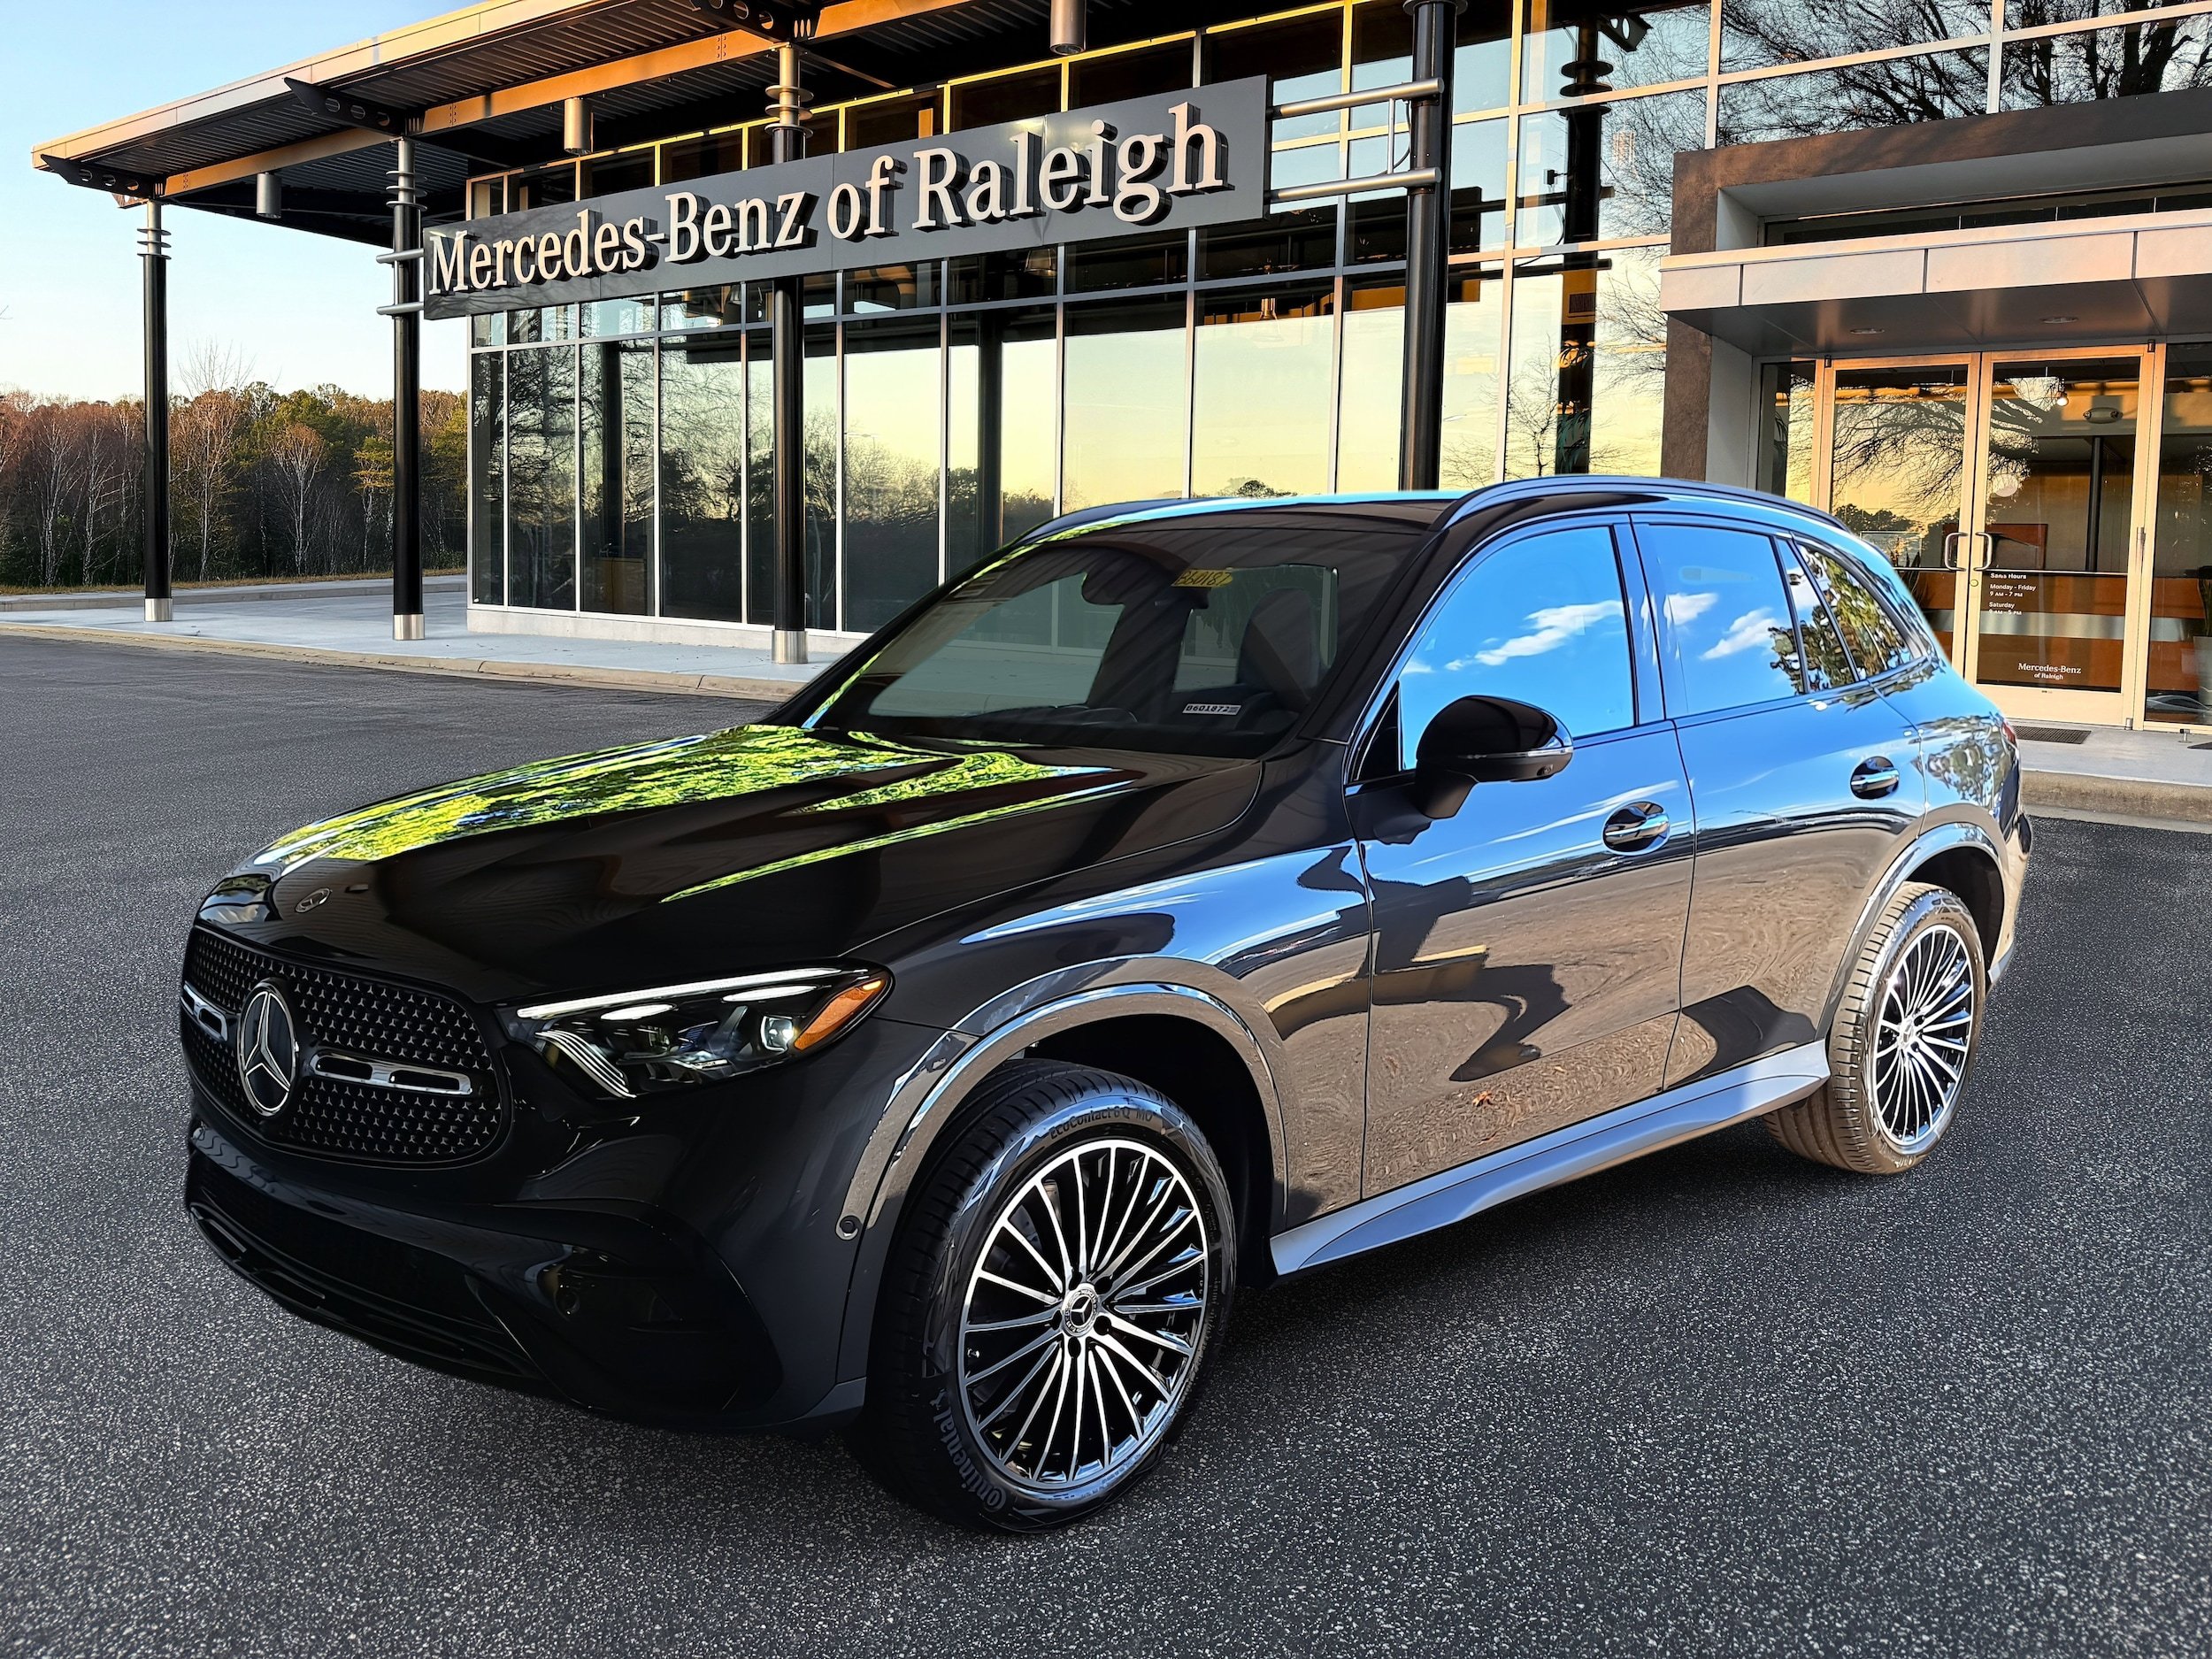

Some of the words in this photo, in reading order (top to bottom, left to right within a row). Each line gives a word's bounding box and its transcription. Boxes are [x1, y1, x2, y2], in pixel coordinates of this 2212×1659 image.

[428, 190, 806, 296] Mercedes-Benz
[826, 155, 895, 240] of
[911, 102, 1225, 223] Raleigh
[2018, 663, 2081, 673] Mercedes-Benz
[933, 1406, 1007, 1513] Continental
